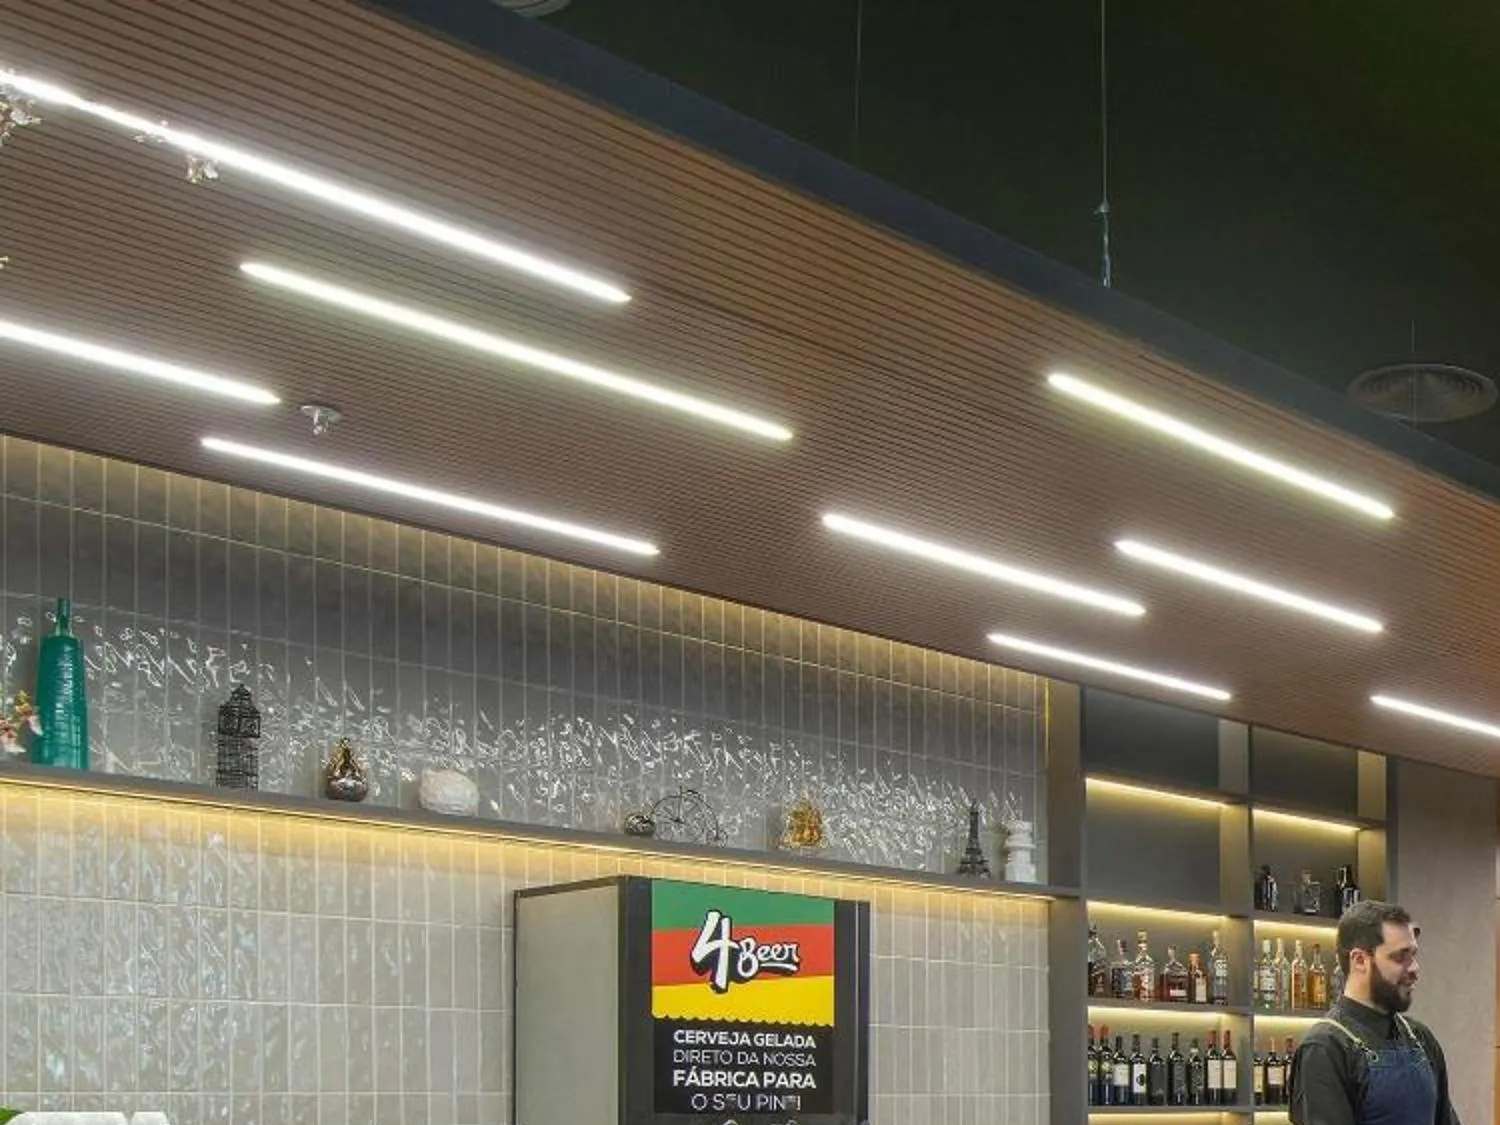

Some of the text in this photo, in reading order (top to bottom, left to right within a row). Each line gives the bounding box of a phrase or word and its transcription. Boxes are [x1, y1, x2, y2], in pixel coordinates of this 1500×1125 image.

[673, 1029, 817, 1048] CERVEJA GELADA
[673, 1049, 817, 1067] DIRETO DA NOSSA
[672, 1066, 817, 1089] FÁBRICA PARA
[691, 1093, 708, 1111] O
